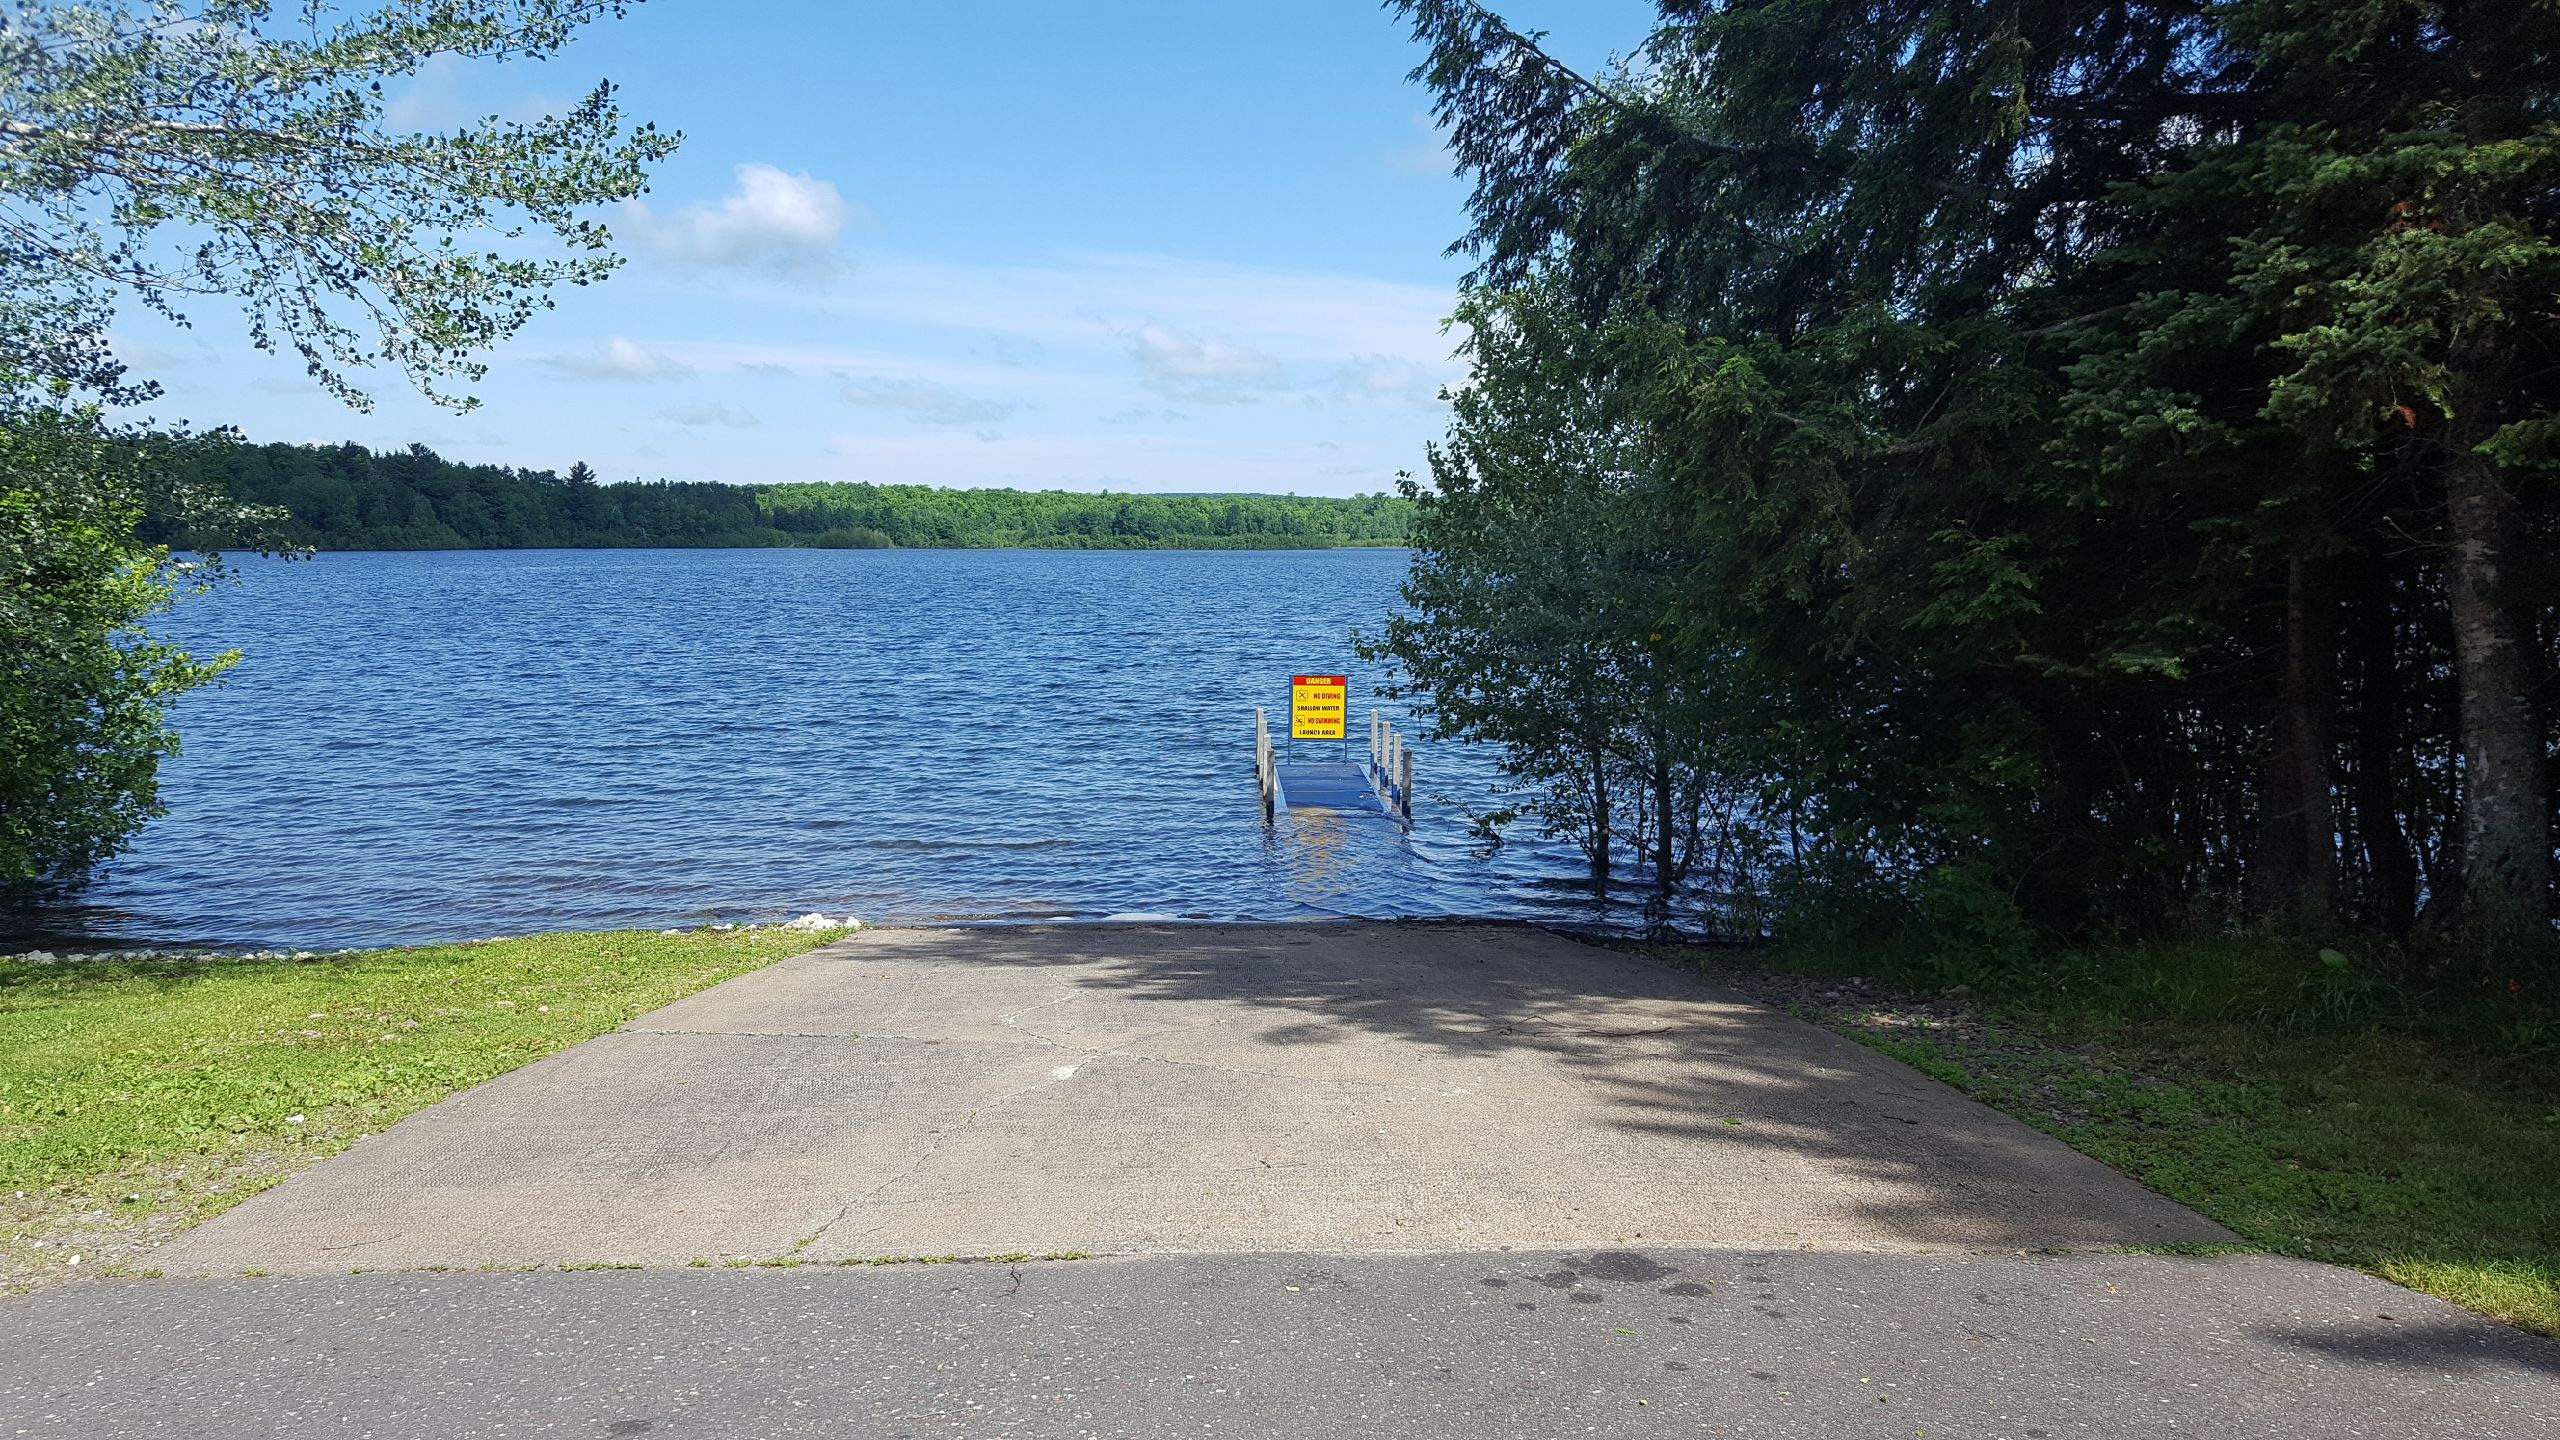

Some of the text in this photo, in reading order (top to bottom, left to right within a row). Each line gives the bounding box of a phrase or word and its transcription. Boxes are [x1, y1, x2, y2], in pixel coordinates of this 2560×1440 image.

[1305, 677, 1332, 685] DANGER
[1321, 692, 1341, 700] DIVING
[1307, 717, 1341, 725] NO SWIMMING
